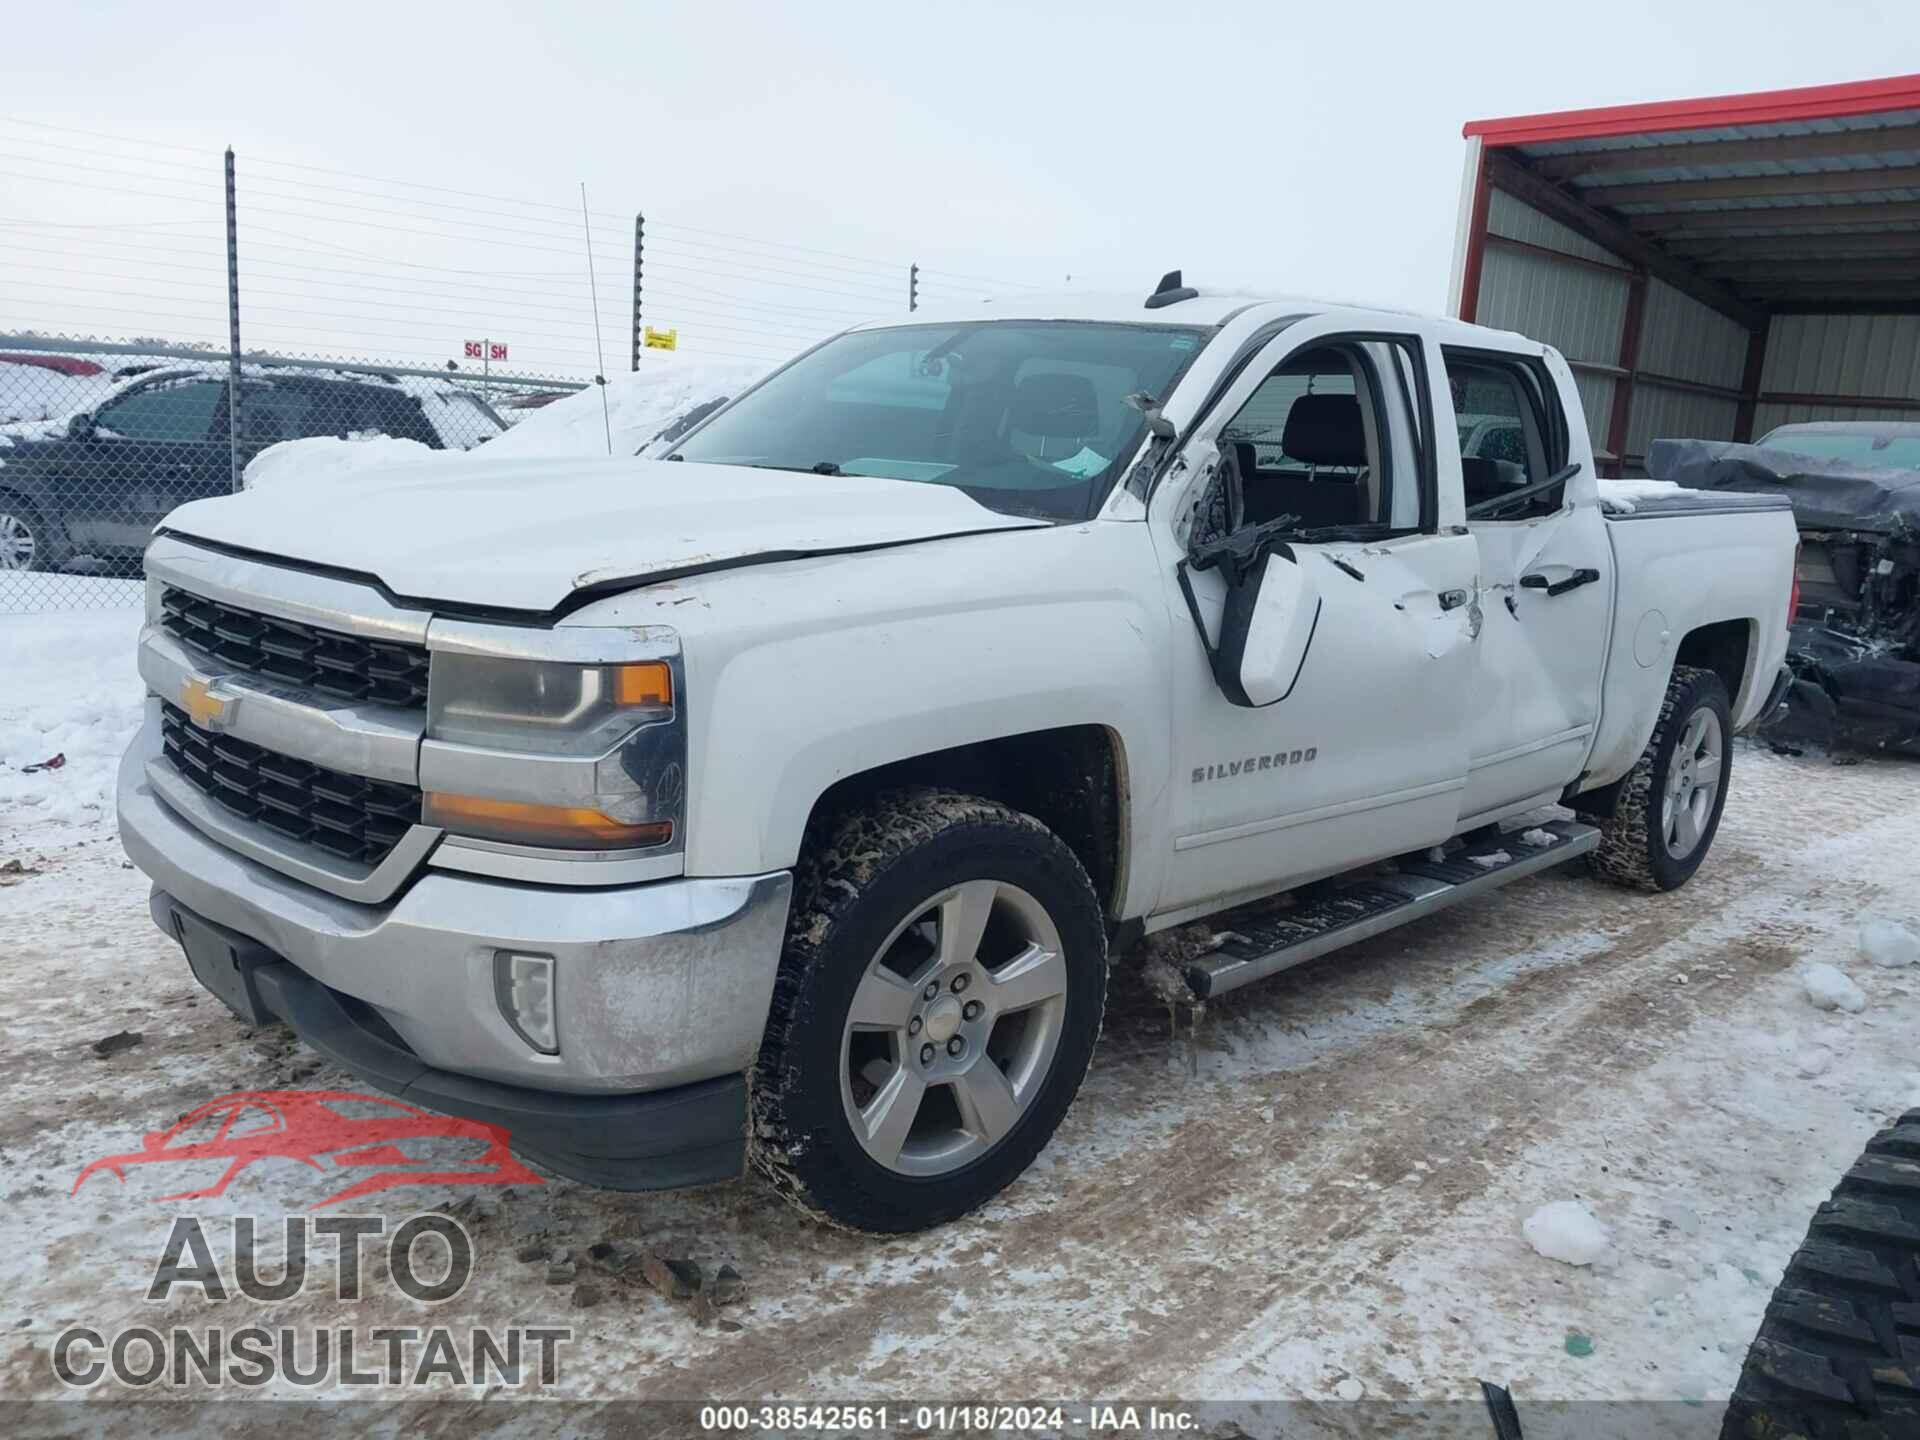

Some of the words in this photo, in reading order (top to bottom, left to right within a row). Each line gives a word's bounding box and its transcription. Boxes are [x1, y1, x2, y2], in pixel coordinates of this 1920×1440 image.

[465, 342, 482, 357] SG
[491, 345, 508, 360] SH
[1192, 747, 1318, 784] SILVERADO
